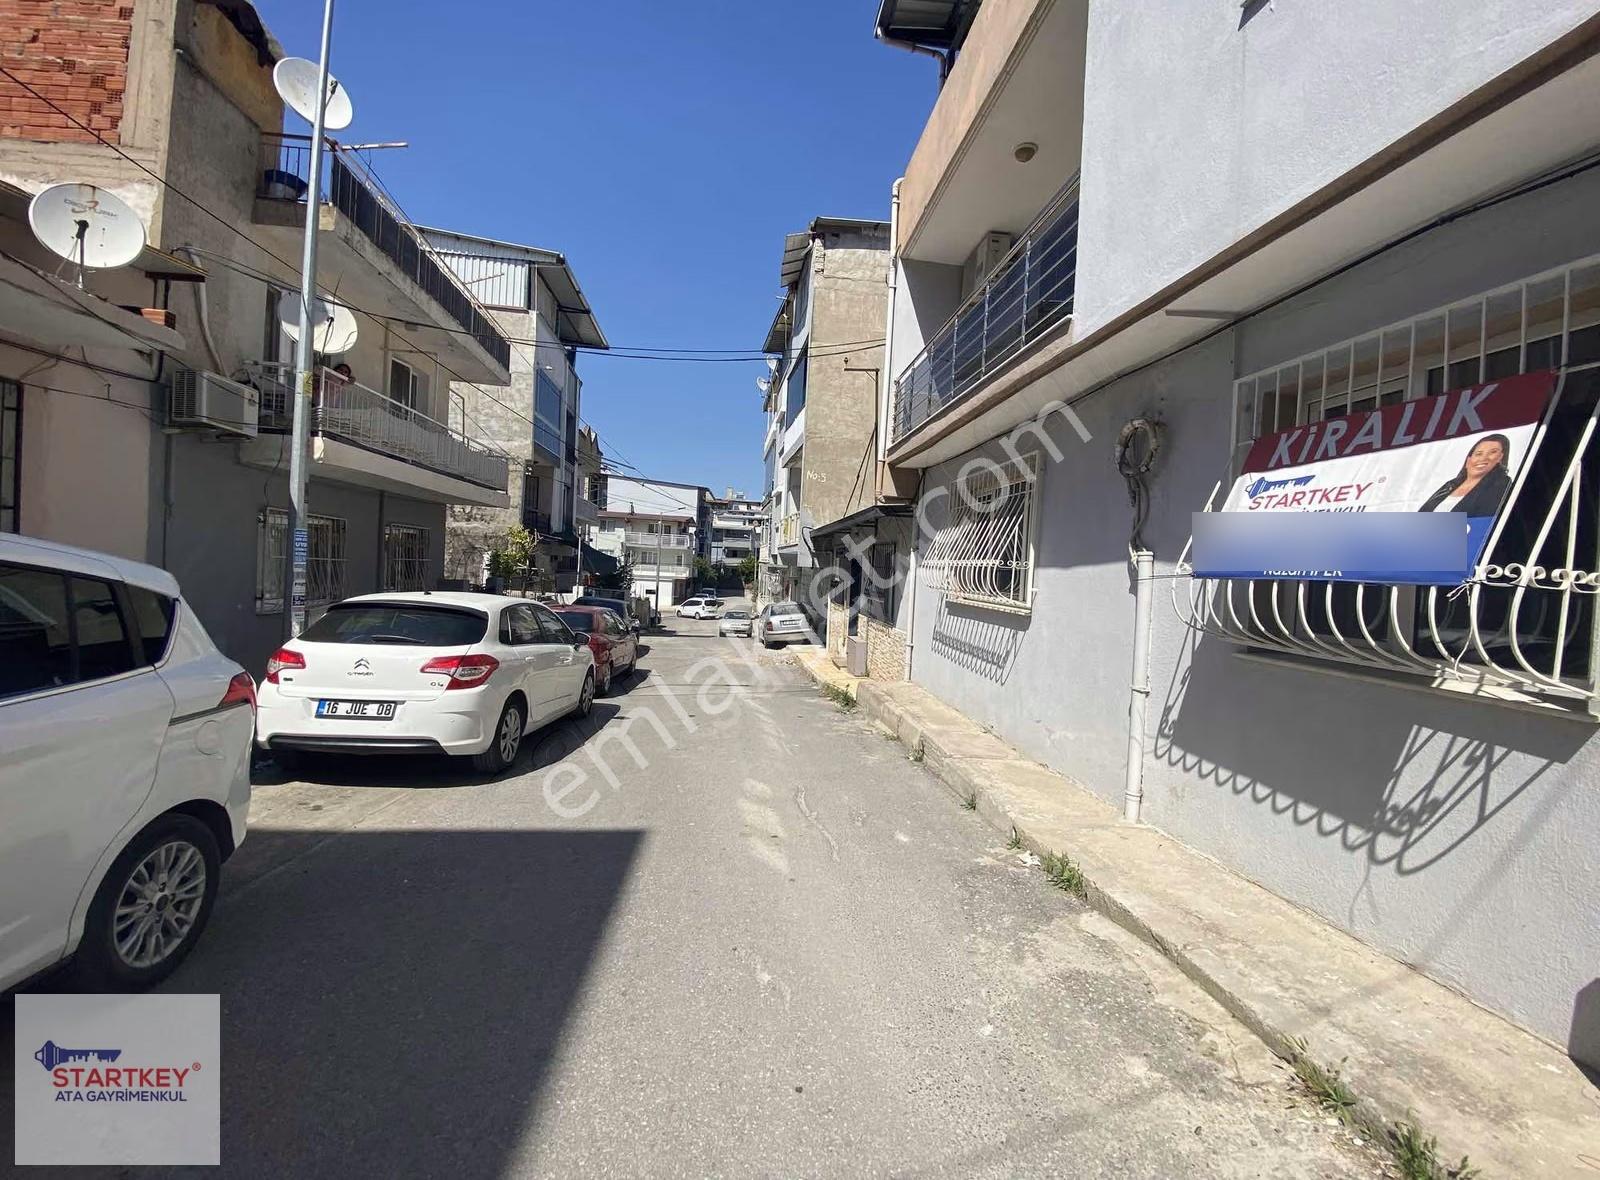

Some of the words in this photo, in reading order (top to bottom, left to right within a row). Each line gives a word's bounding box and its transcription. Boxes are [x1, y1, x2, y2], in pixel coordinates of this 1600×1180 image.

[1268, 383, 1499, 468] KİRALIK
[1248, 481, 1373, 511] STARTKEY
[326, 702, 339, 714] 16
[346, 702, 370, 715] JUE
[376, 703, 393, 716] 08
